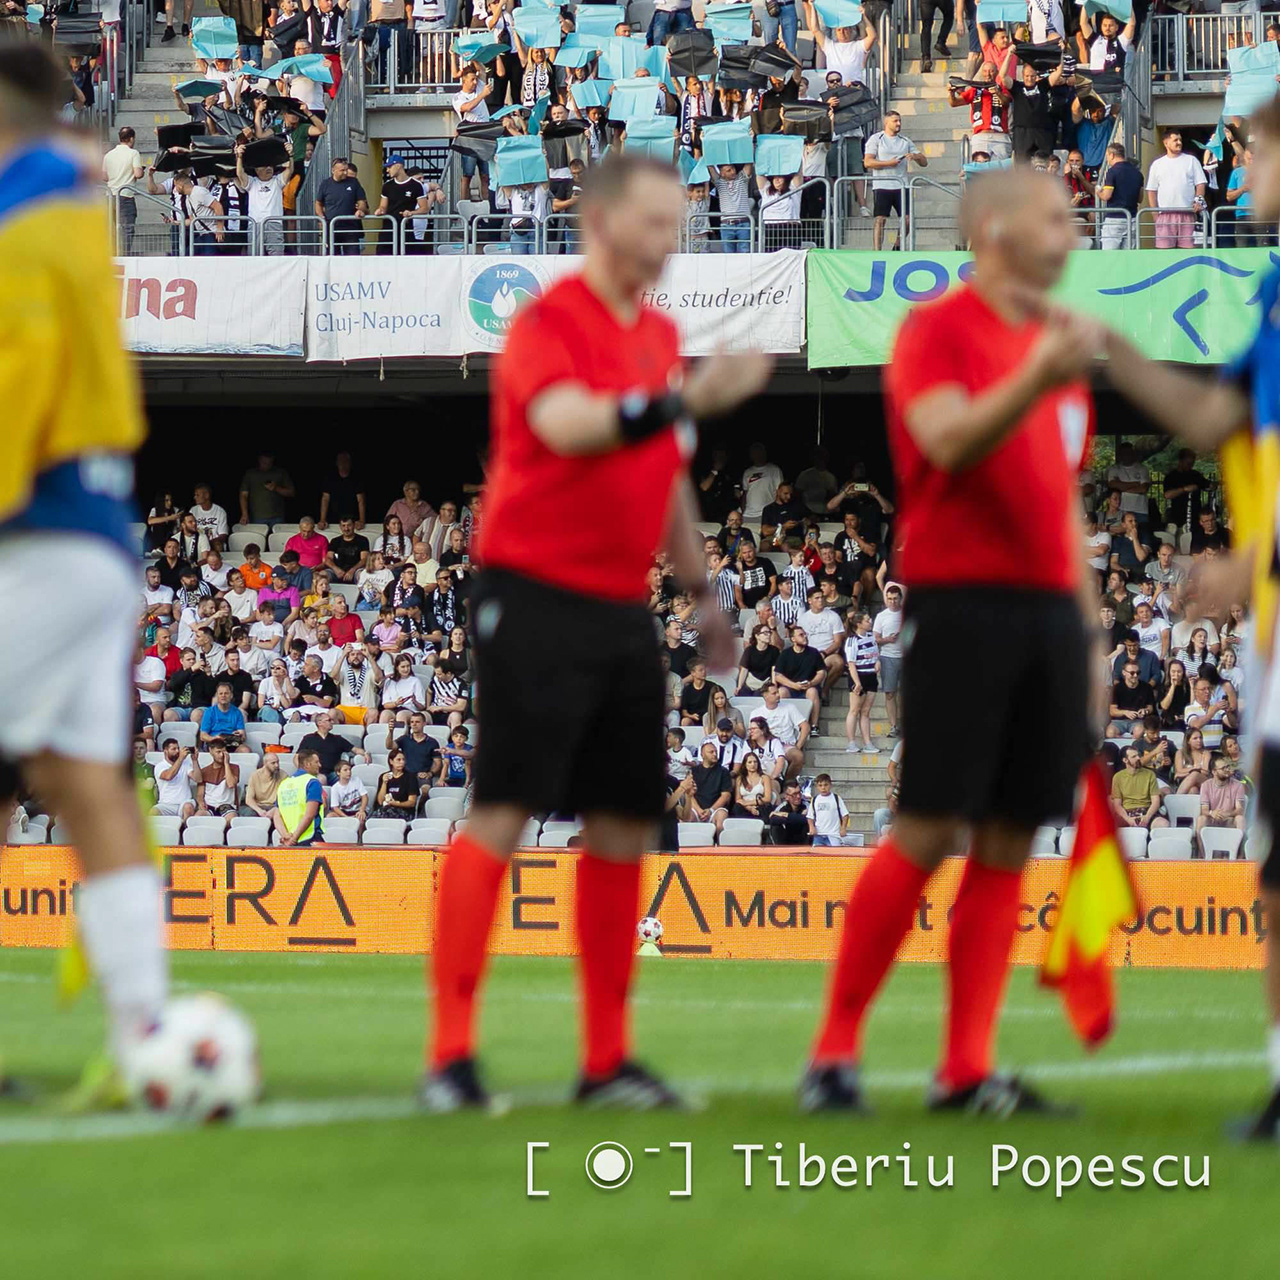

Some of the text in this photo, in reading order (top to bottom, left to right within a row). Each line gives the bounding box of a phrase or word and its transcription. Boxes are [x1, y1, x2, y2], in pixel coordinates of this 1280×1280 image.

[495, 269, 520, 279] 1869
[315, 281, 391, 302] USAMV
[679, 285, 793, 311] studenție!
[315, 310, 442, 336] Cluj-Napoca
[164, 853, 356, 926] ERA
[512, 859, 710, 934] EA
[725, 890, 809, 928] Mai
